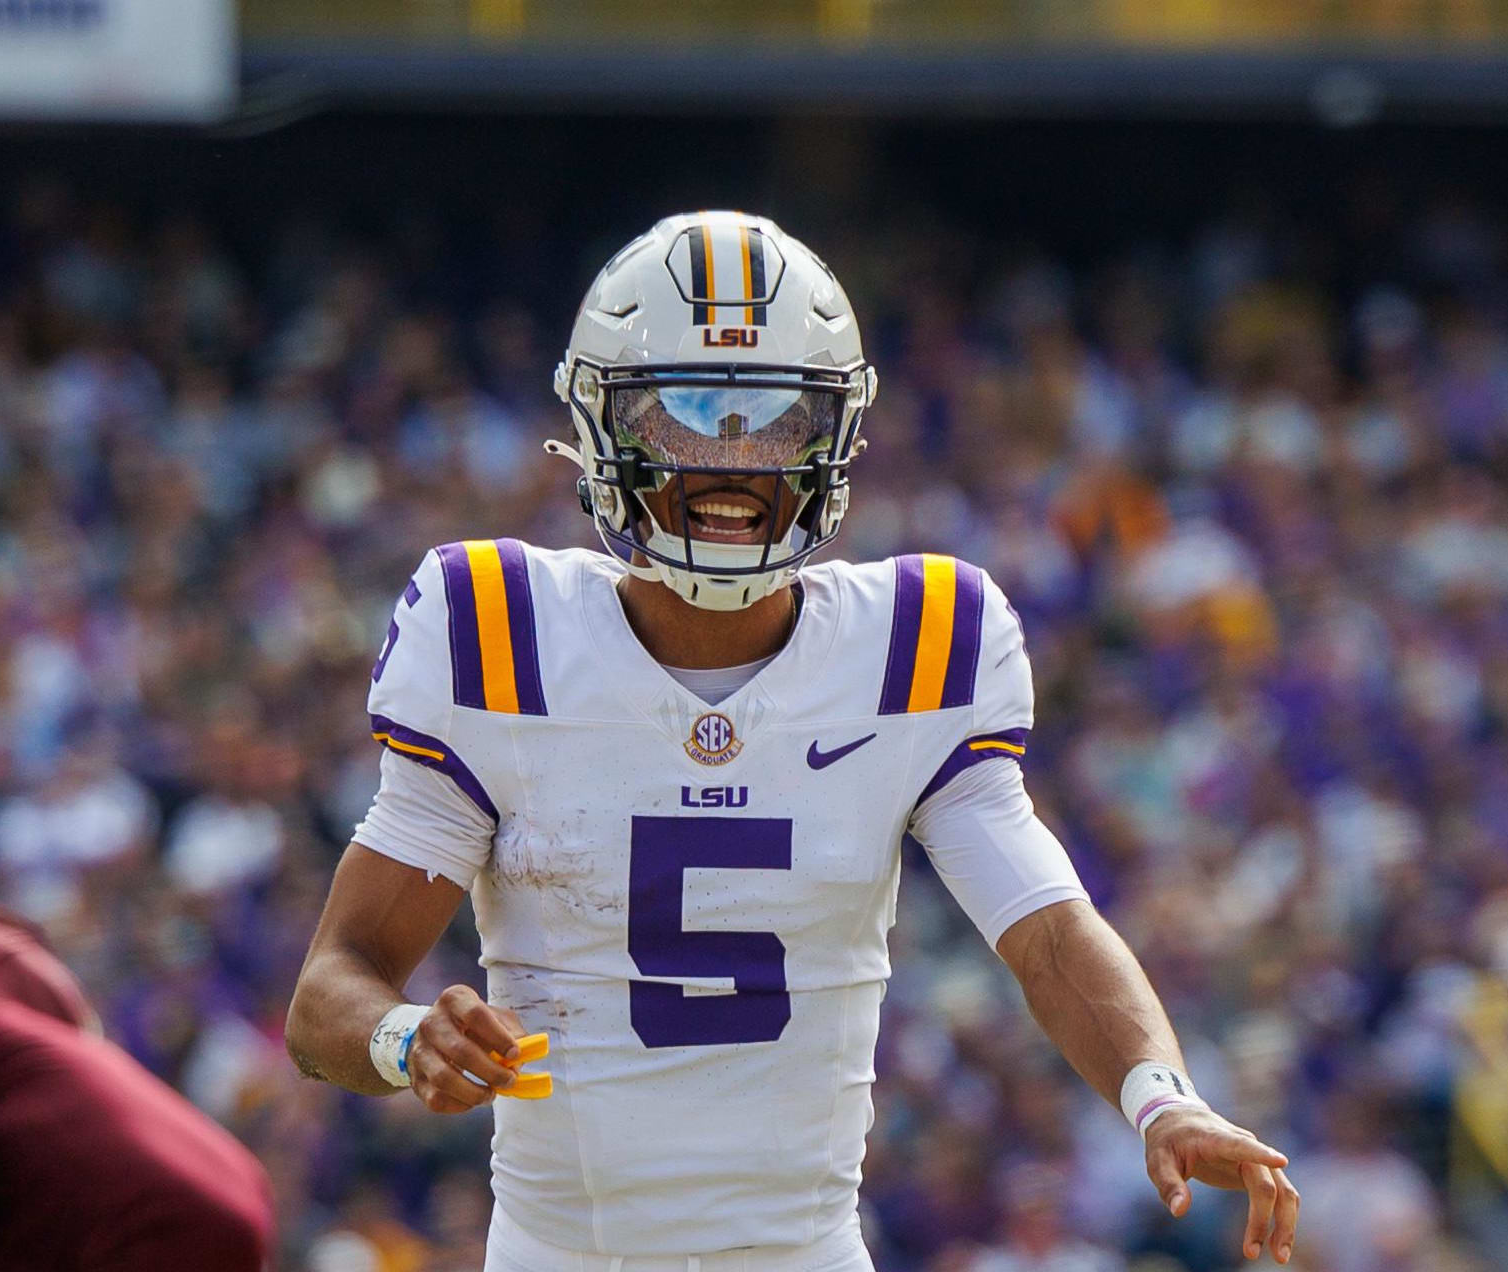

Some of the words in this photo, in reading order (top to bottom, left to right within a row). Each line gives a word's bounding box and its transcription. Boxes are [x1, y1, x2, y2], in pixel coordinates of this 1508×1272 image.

[703, 328, 759, 348] LSU
[696, 714, 732, 753] SEC
[680, 785, 749, 808] LSU
[628, 815, 793, 1049] 5
